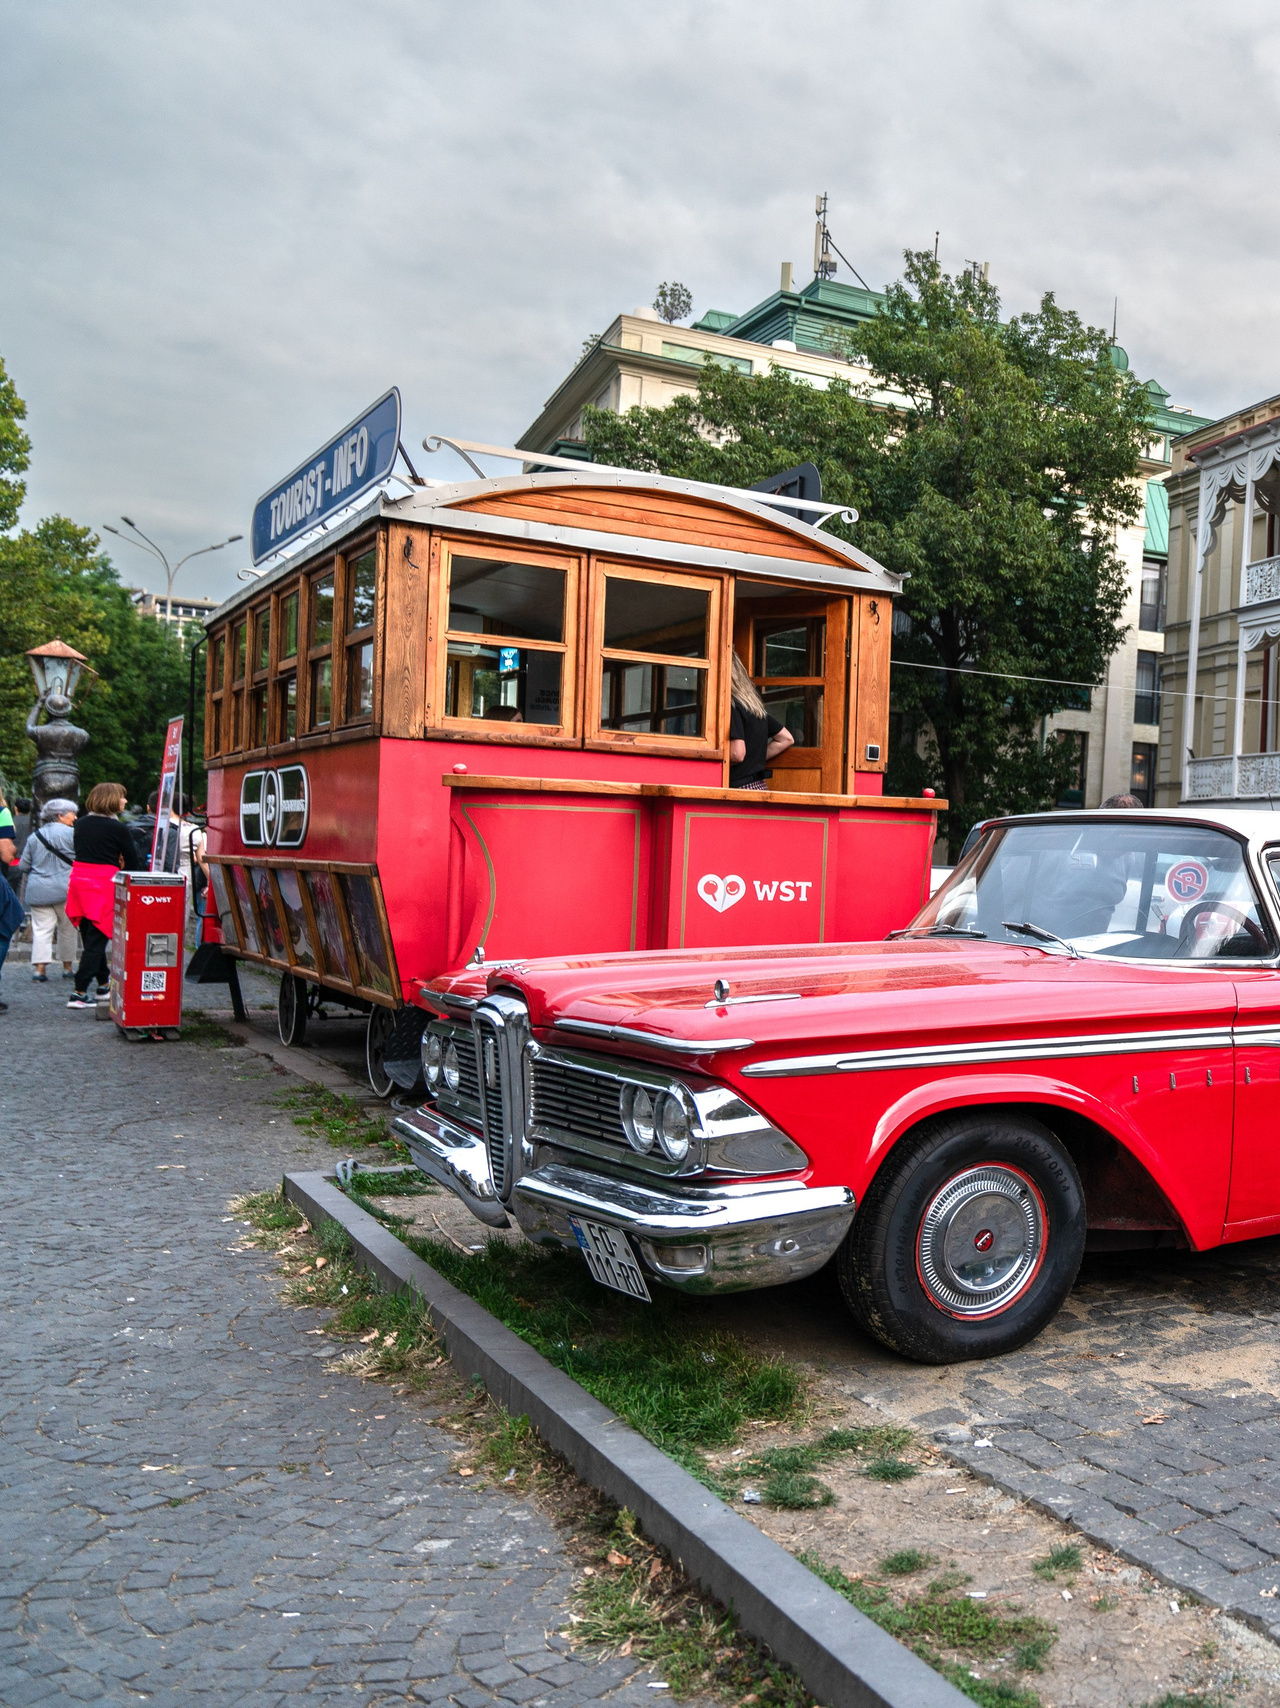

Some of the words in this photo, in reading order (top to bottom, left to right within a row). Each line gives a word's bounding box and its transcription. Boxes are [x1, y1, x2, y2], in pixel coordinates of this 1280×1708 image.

[270, 426, 368, 541] TOURIST-INFO
[154, 896, 172, 904] WST
[753, 880, 812, 902] WST
[1015, 1136, 1071, 1194] 205/70R14
[586, 1250, 647, 1297] 111-RD
